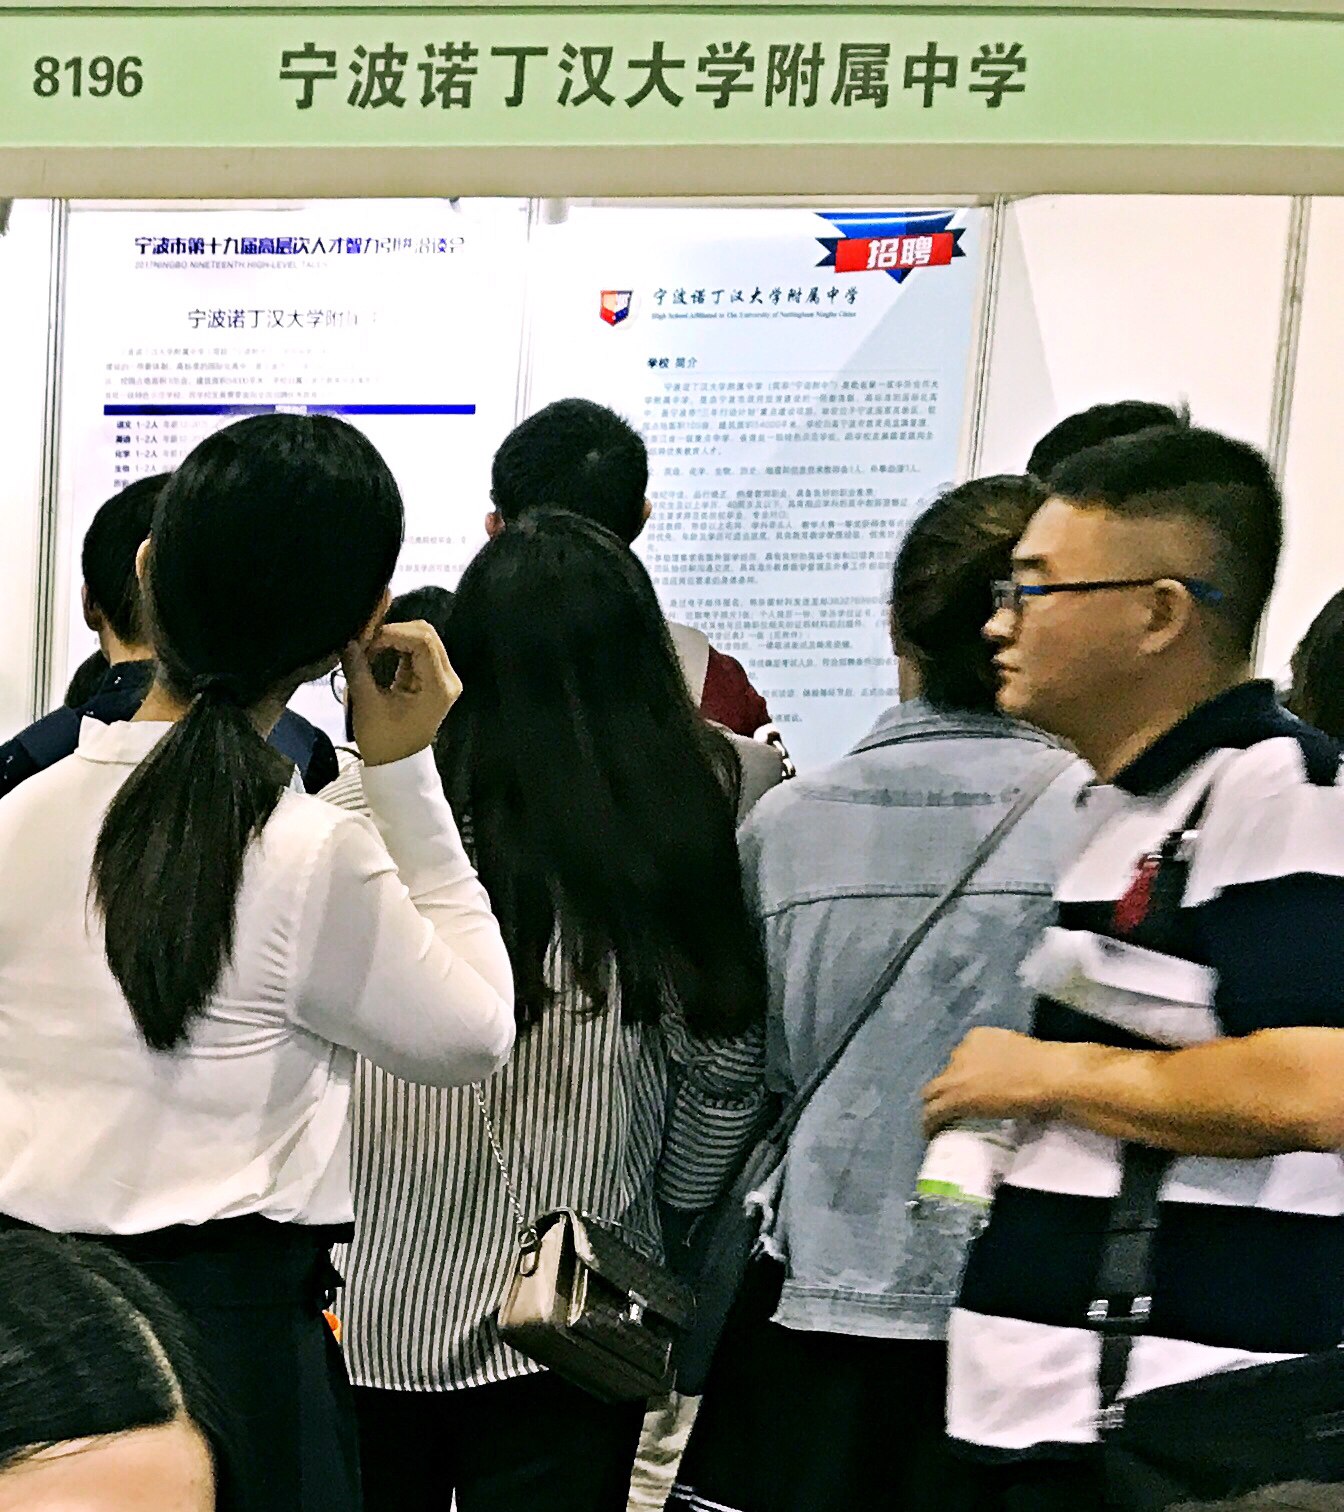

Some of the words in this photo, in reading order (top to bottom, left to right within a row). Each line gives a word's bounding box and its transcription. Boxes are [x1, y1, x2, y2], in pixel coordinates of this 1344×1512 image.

[32, 55, 144, 98] 8196
[278, 41, 1029, 110] 宁波诺丁汉大学附属中学
[868, 238, 933, 268] 招聘
[652, 286, 859, 306] 宁波诺丁汉大学附属中学
